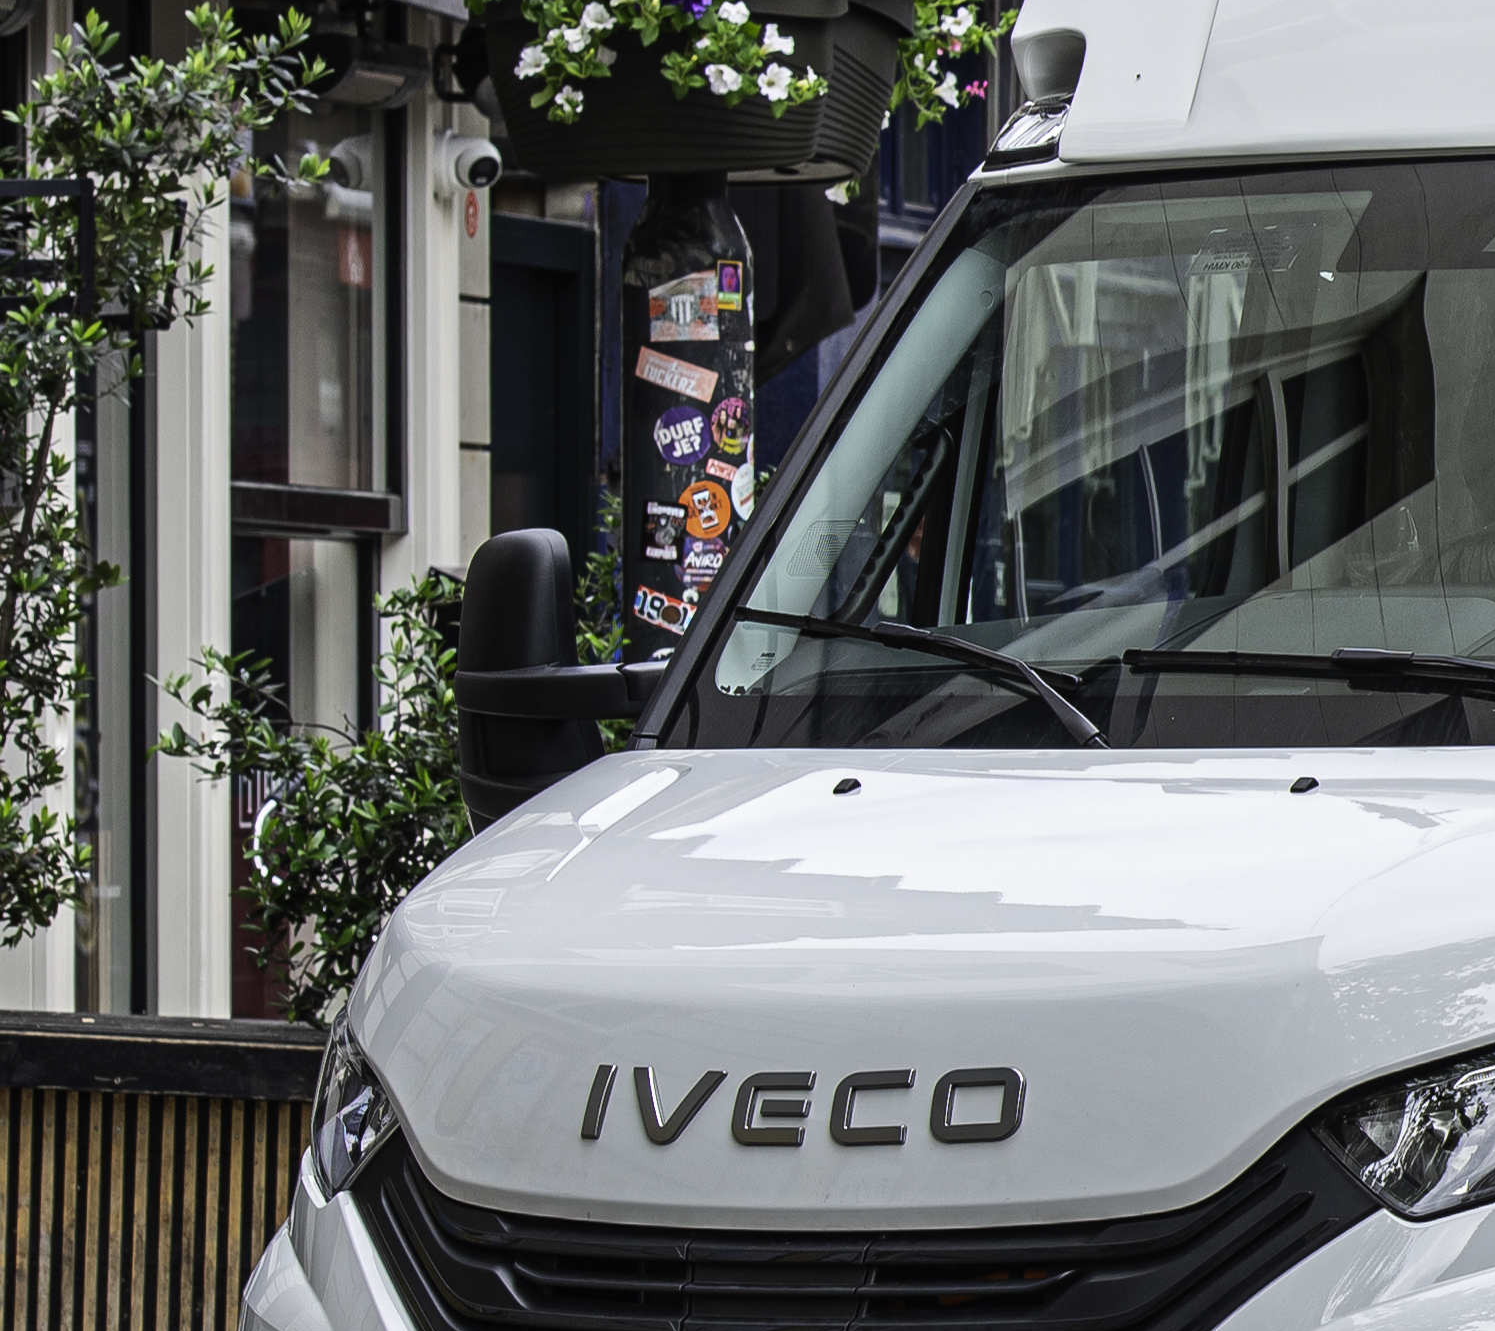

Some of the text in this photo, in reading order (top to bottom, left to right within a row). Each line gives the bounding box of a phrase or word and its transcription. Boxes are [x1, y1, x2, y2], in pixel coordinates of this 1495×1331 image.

[659, 416, 704, 445] DURF
[672, 435, 701, 458] JE?
[580, 1063, 1028, 1147] IVECO
